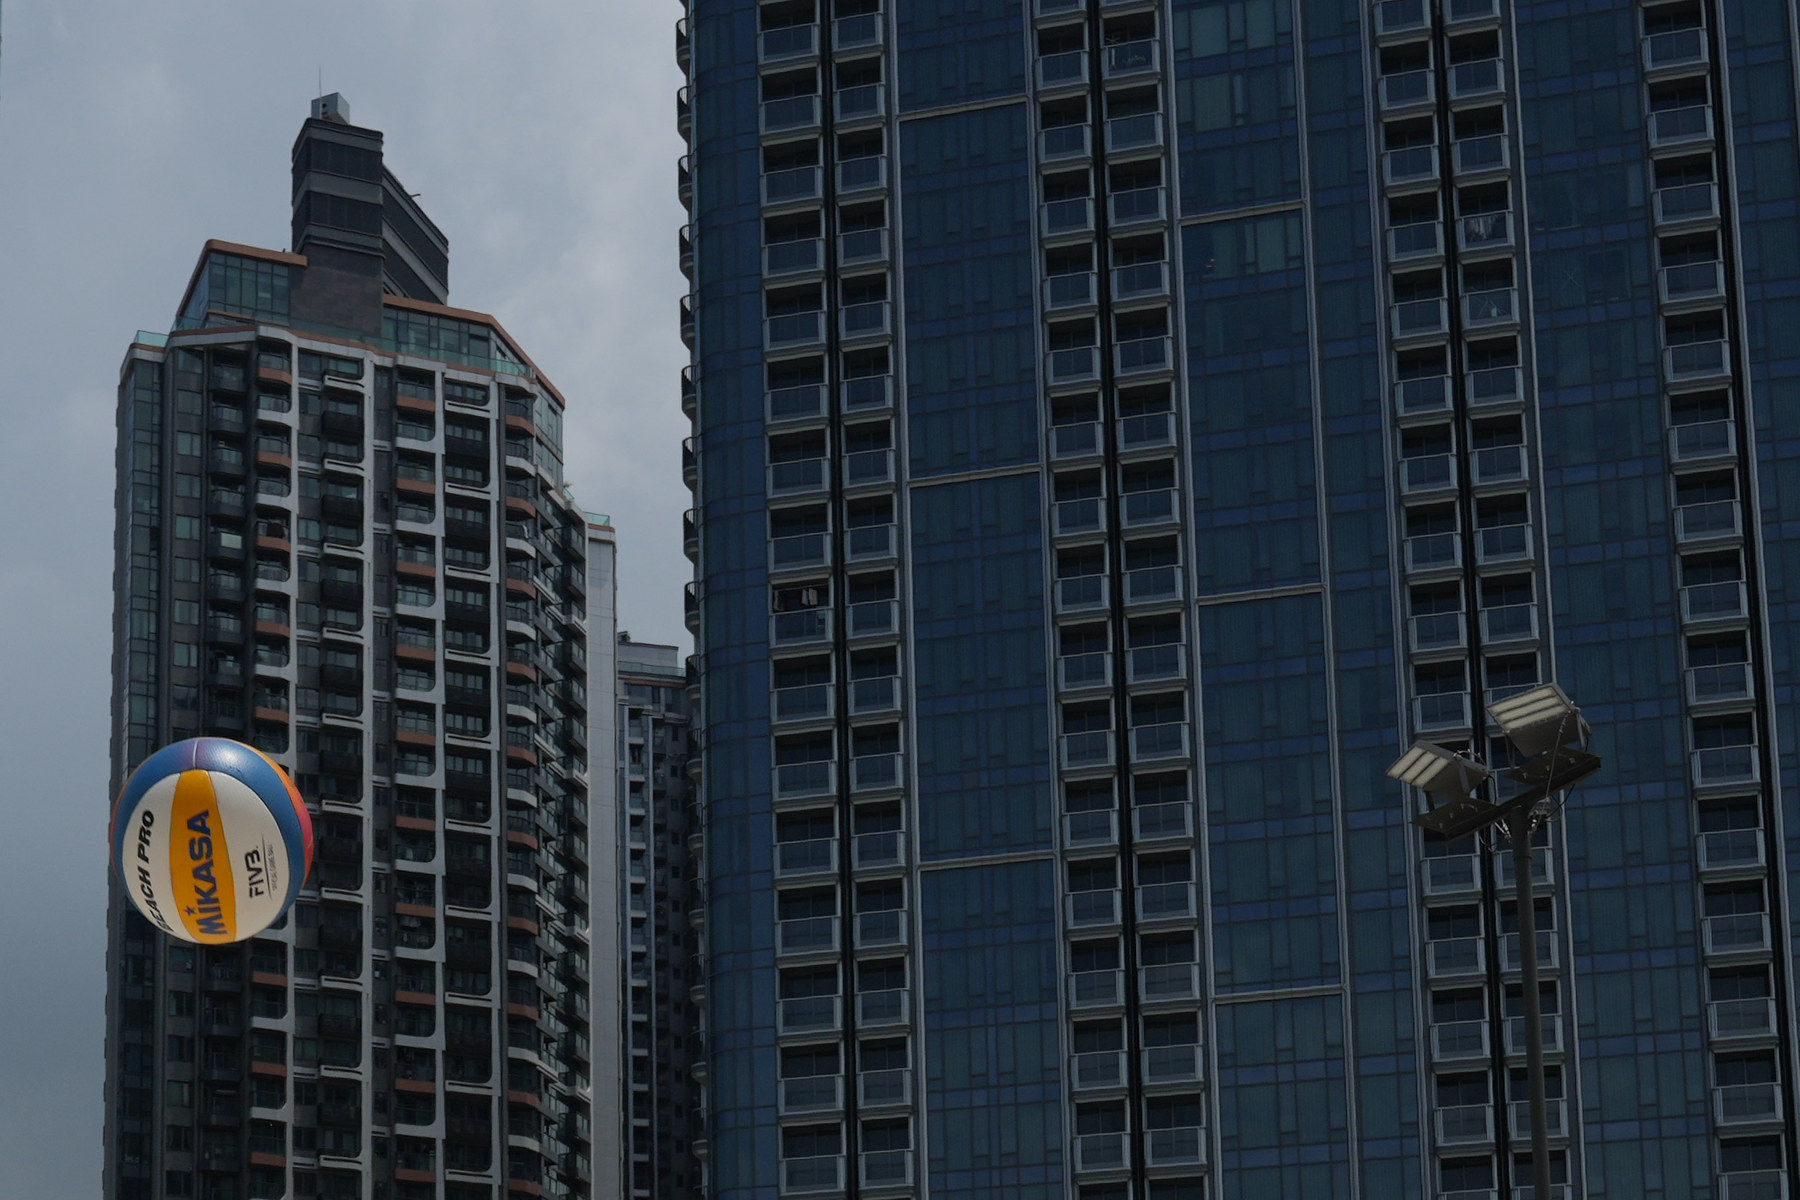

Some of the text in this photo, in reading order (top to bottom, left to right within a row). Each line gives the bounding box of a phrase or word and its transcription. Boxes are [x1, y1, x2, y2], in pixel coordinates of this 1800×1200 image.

[138, 810, 174, 932] BEACH PRO
[184, 809, 228, 935] MIKASA
[245, 846, 264, 898] FIVB
